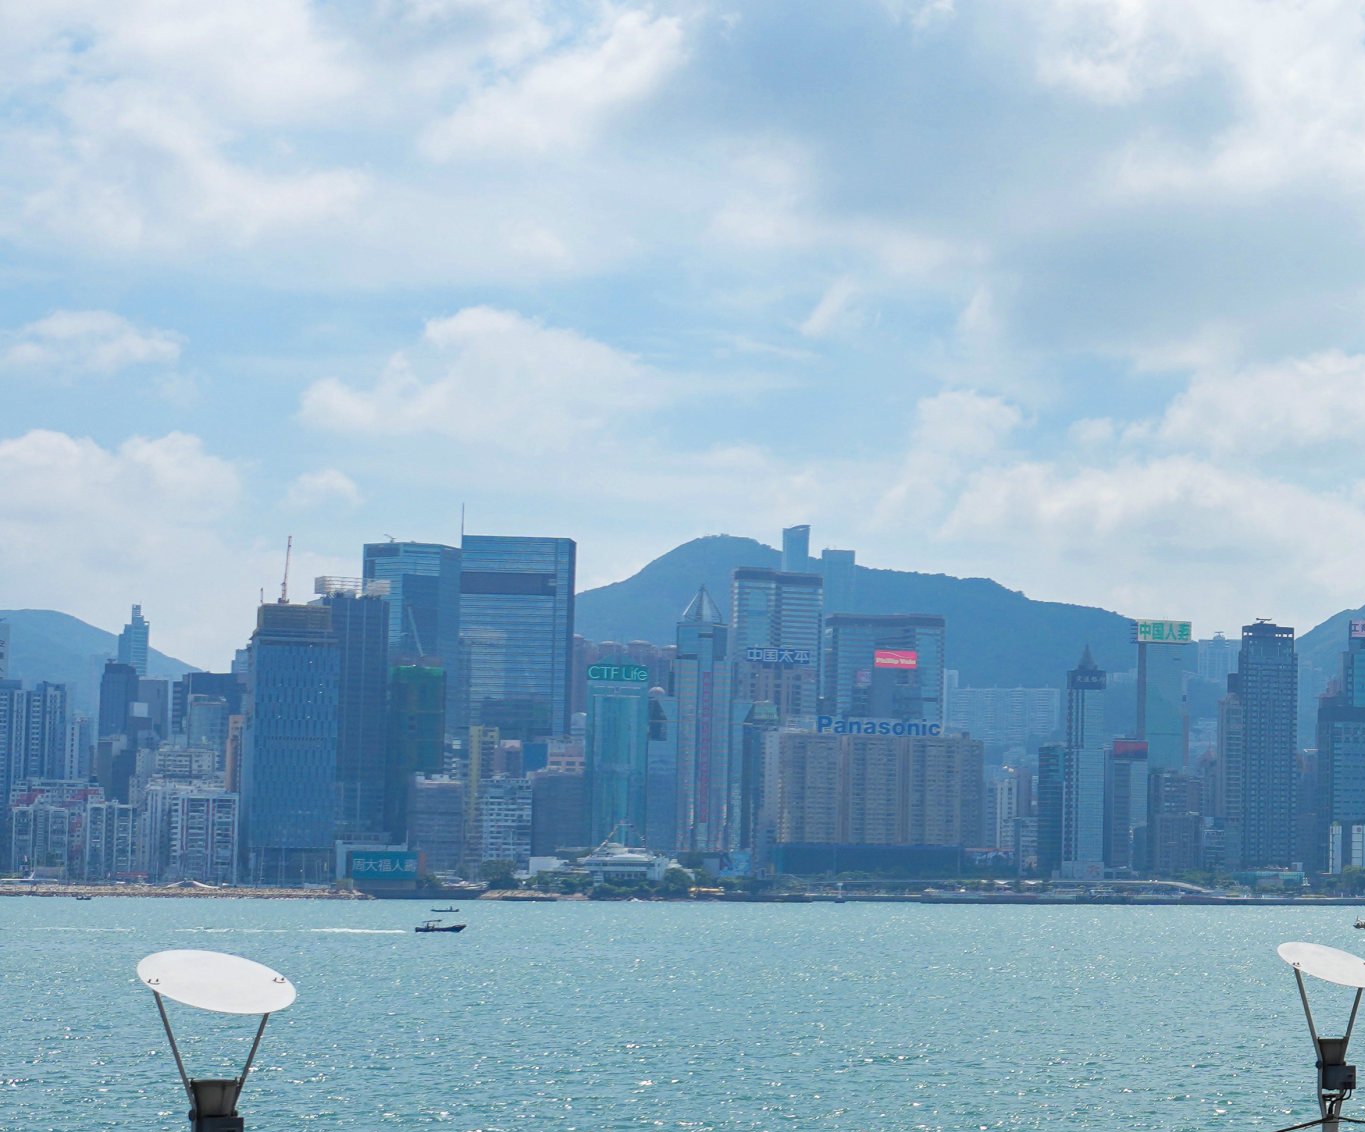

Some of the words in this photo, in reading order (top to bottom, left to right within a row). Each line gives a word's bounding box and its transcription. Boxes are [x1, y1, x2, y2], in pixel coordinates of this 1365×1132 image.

[1139, 622, 1190, 641] 中国人寿
[747, 648, 810, 664] 中国太平
[588, 666, 620, 680] CTF
[622, 666, 648, 681] Life
[817, 715, 941, 736] Panasonic
